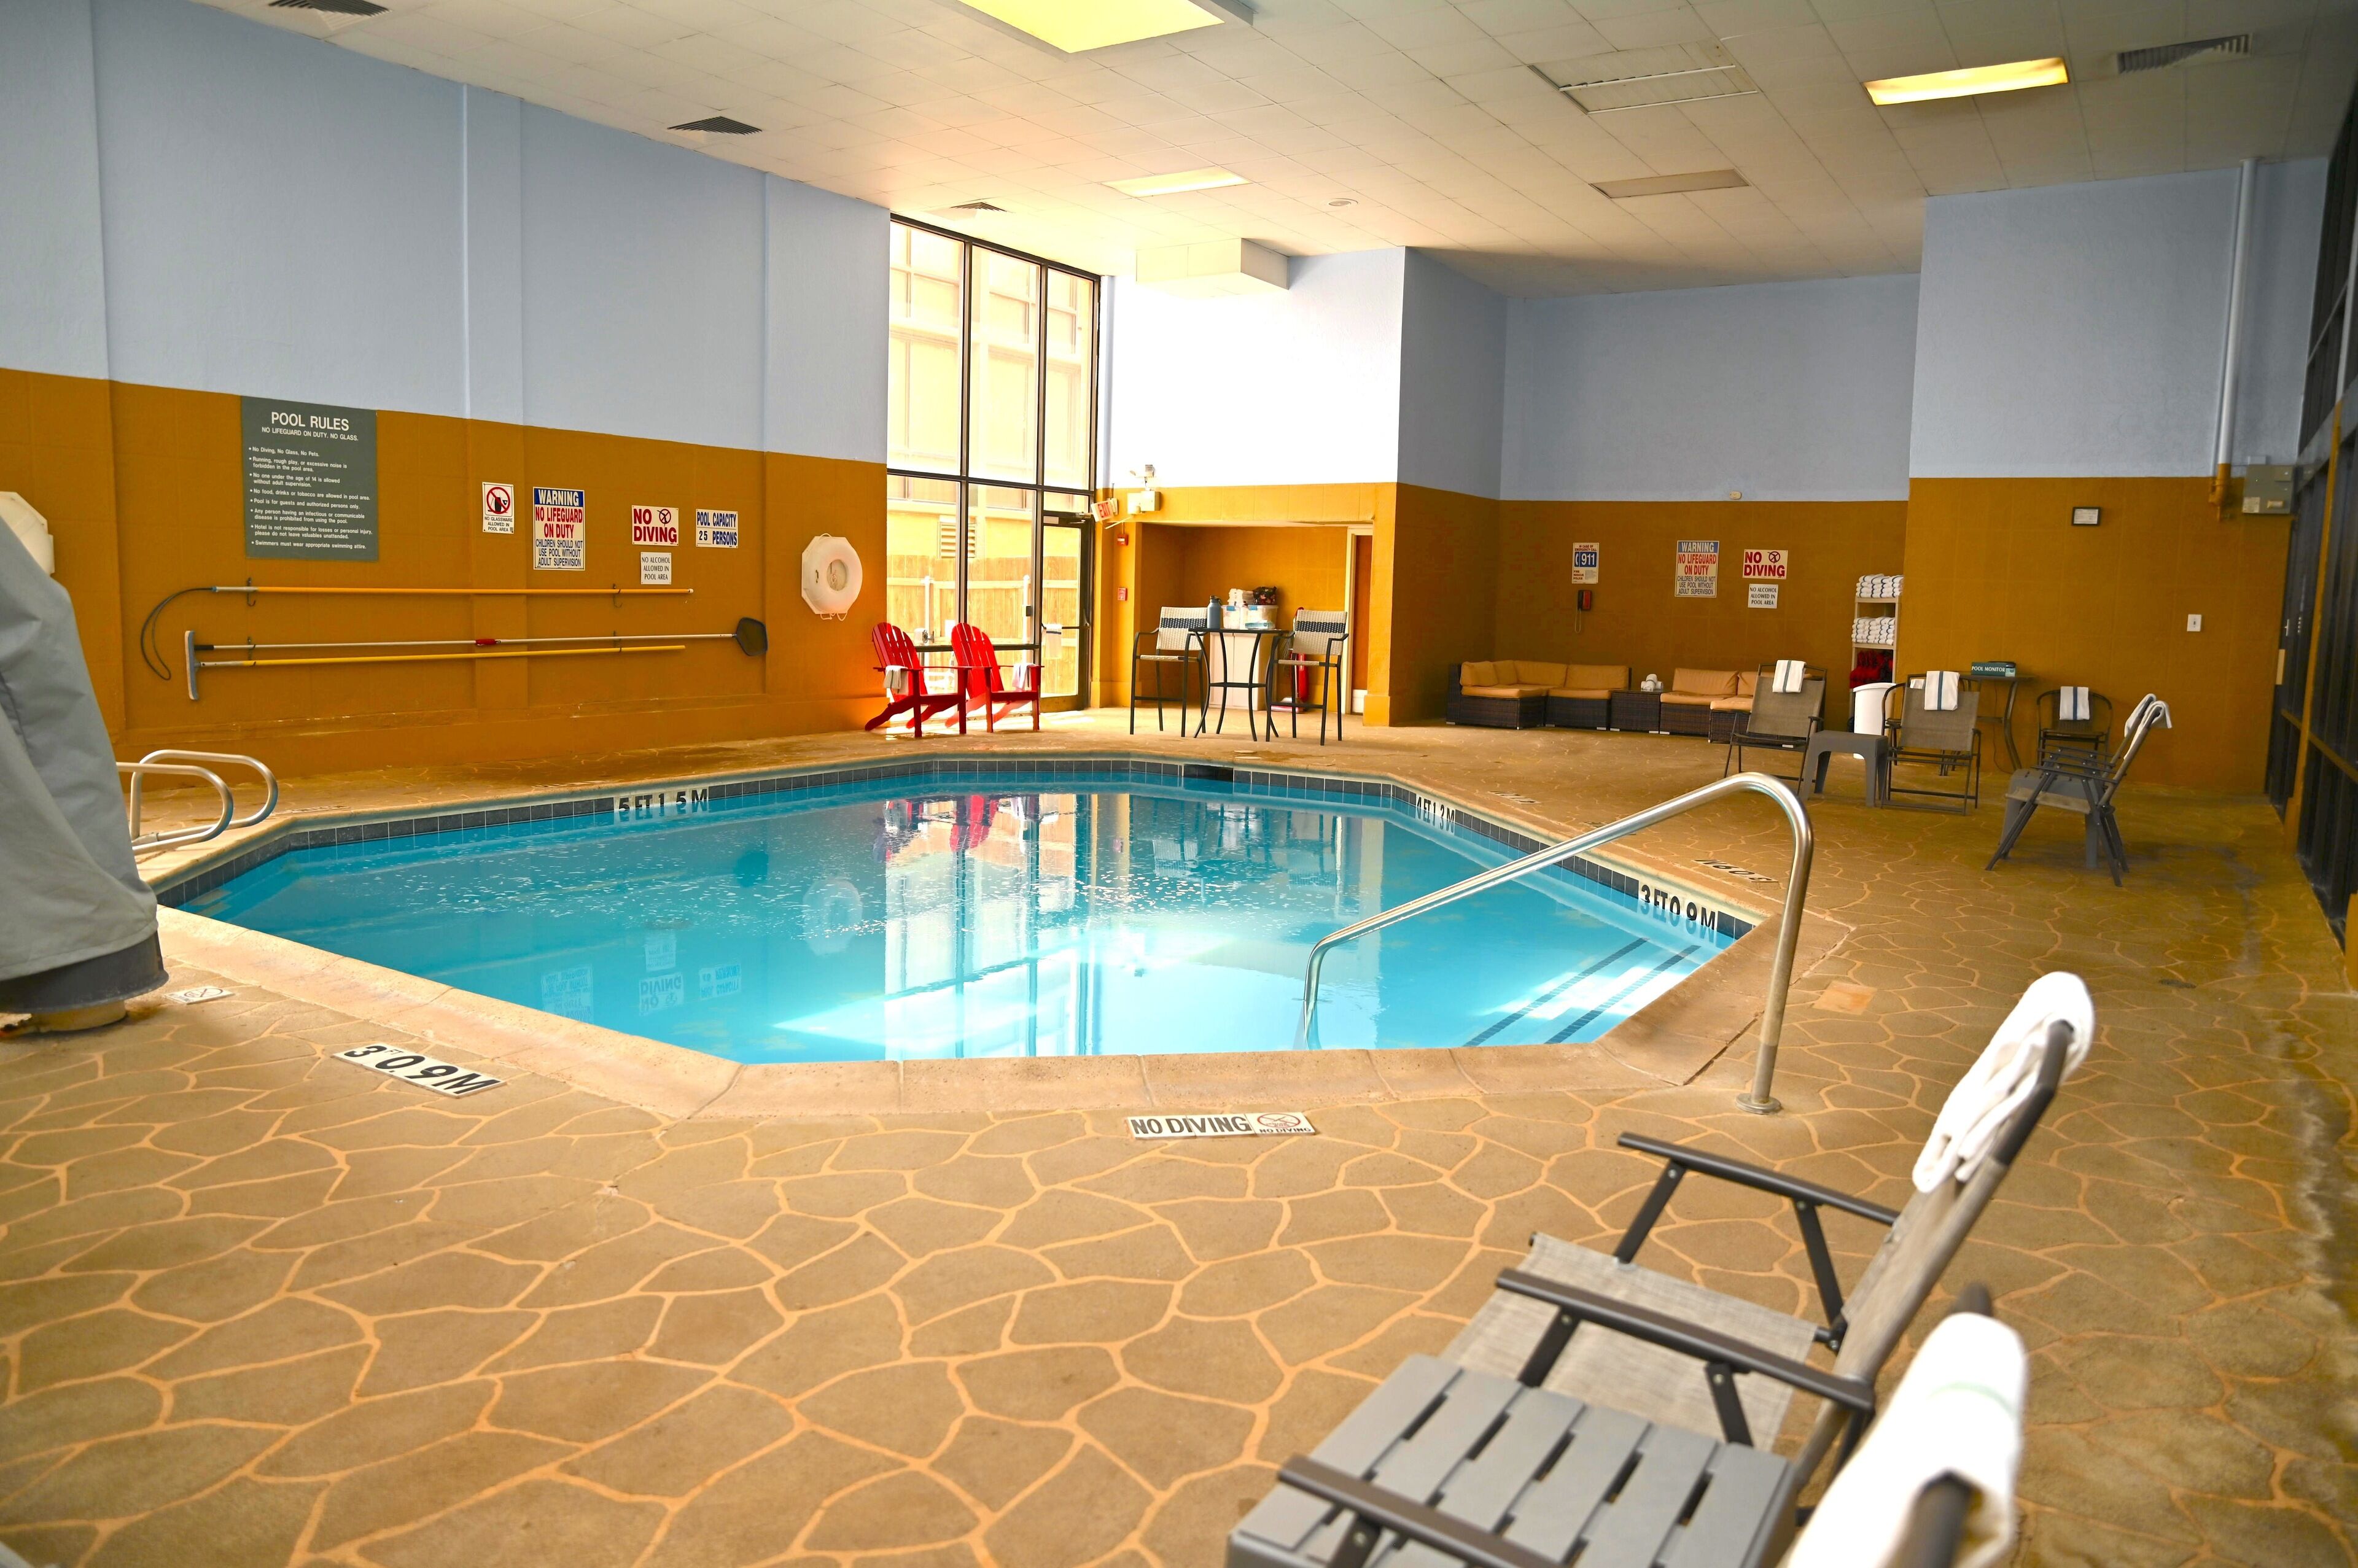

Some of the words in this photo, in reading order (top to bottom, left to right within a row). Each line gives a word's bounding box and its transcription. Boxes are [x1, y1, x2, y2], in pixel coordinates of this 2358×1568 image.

[271, 412, 305, 427] POOL
[311, 416, 349, 431] RULES
[539, 489, 578, 506] WARNING
[535, 506, 544, 521] NO
[547, 507, 582, 523] LIFEGUARD
[634, 508, 652, 525] NO
[1098, 502, 1110, 518] EXIT
[697, 512, 710, 526] POOL
[713, 513, 736, 527] CAPACITY
[544, 523, 553, 538] ON
[556, 524, 574, 538] DUTY
[634, 526, 677, 543] DIVING
[699, 530, 707, 541] 25
[712, 531, 737, 546] PERSONS
[536, 539, 555, 548] CHILDREN
[558, 540, 573, 548] SHOULD
[1682, 542, 1714, 552] WARNING
[562, 549, 580, 557] WITHOUT
[1582, 553, 1595, 565] 911
[1678, 554, 1685, 564] NO
[1687, 554, 1716, 564] LIFEGUARD
[1745, 551, 1762, 564] NO
[1684, 565, 1692, 575] ON
[1694, 565, 1709, 575] DUTY
[1744, 564, 1784, 576] DIVING
[1130, 1119, 1163, 1134] NO
[1165, 1117, 1253, 1133] DIVING
